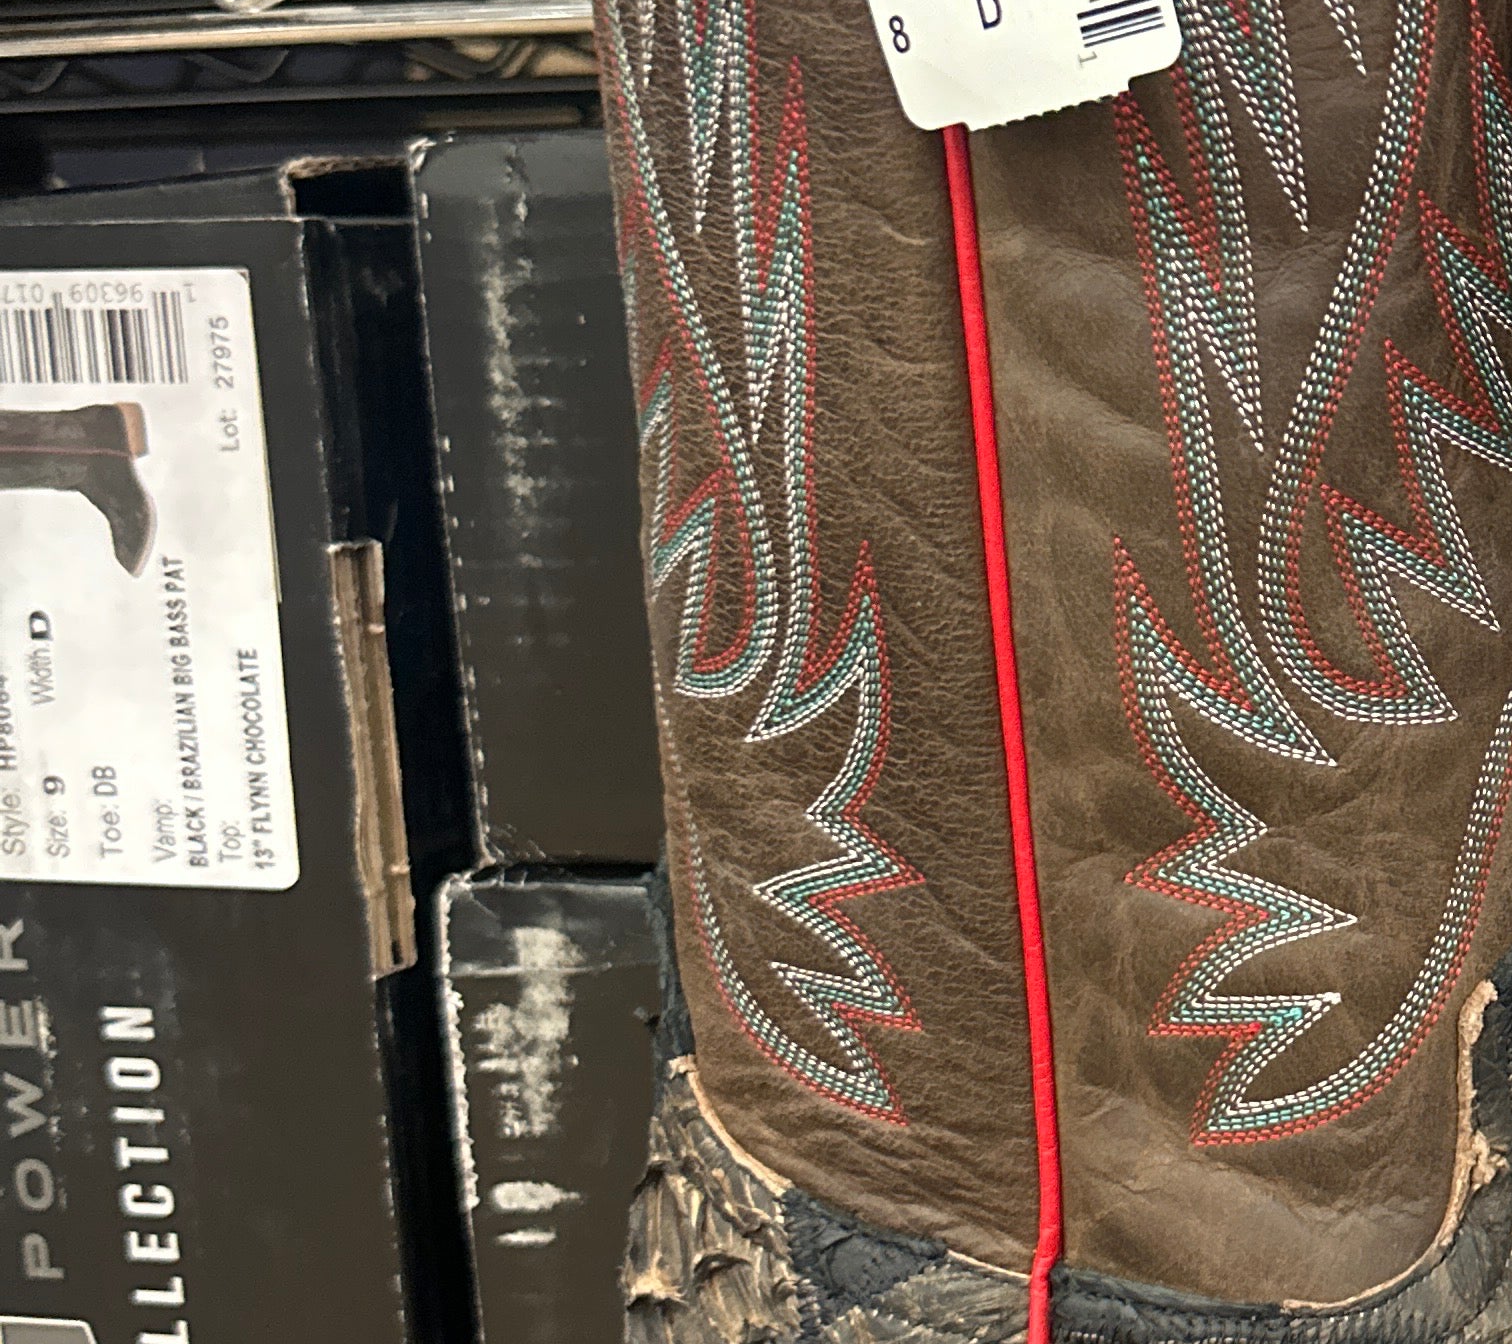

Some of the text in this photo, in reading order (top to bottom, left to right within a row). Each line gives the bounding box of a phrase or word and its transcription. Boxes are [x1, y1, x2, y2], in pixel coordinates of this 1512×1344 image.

[889, 15, 912, 55] 8
[69, 281, 144, 304] 96309
[207, 316, 242, 454] Lot: 27975
[161, 555, 187, 594] PAT
[28, 609, 53, 641] D
[165, 599, 190, 648] BASS
[172, 652, 194, 686] BIG
[237, 647, 267, 766] CHOCOLATE
[173, 692, 202, 792] BRAZILIAN
[42, 774, 66, 797] 9
[248, 770, 274, 836] FLYNN
[0, 789, 31, 857] Style:
[46, 810, 71, 859] Size:
[91, 765, 124, 859] Toe: DB
[152, 798, 180, 864] Vamp:
[185, 806, 210, 869] BLACK
[217, 820, 247, 864] Top:
